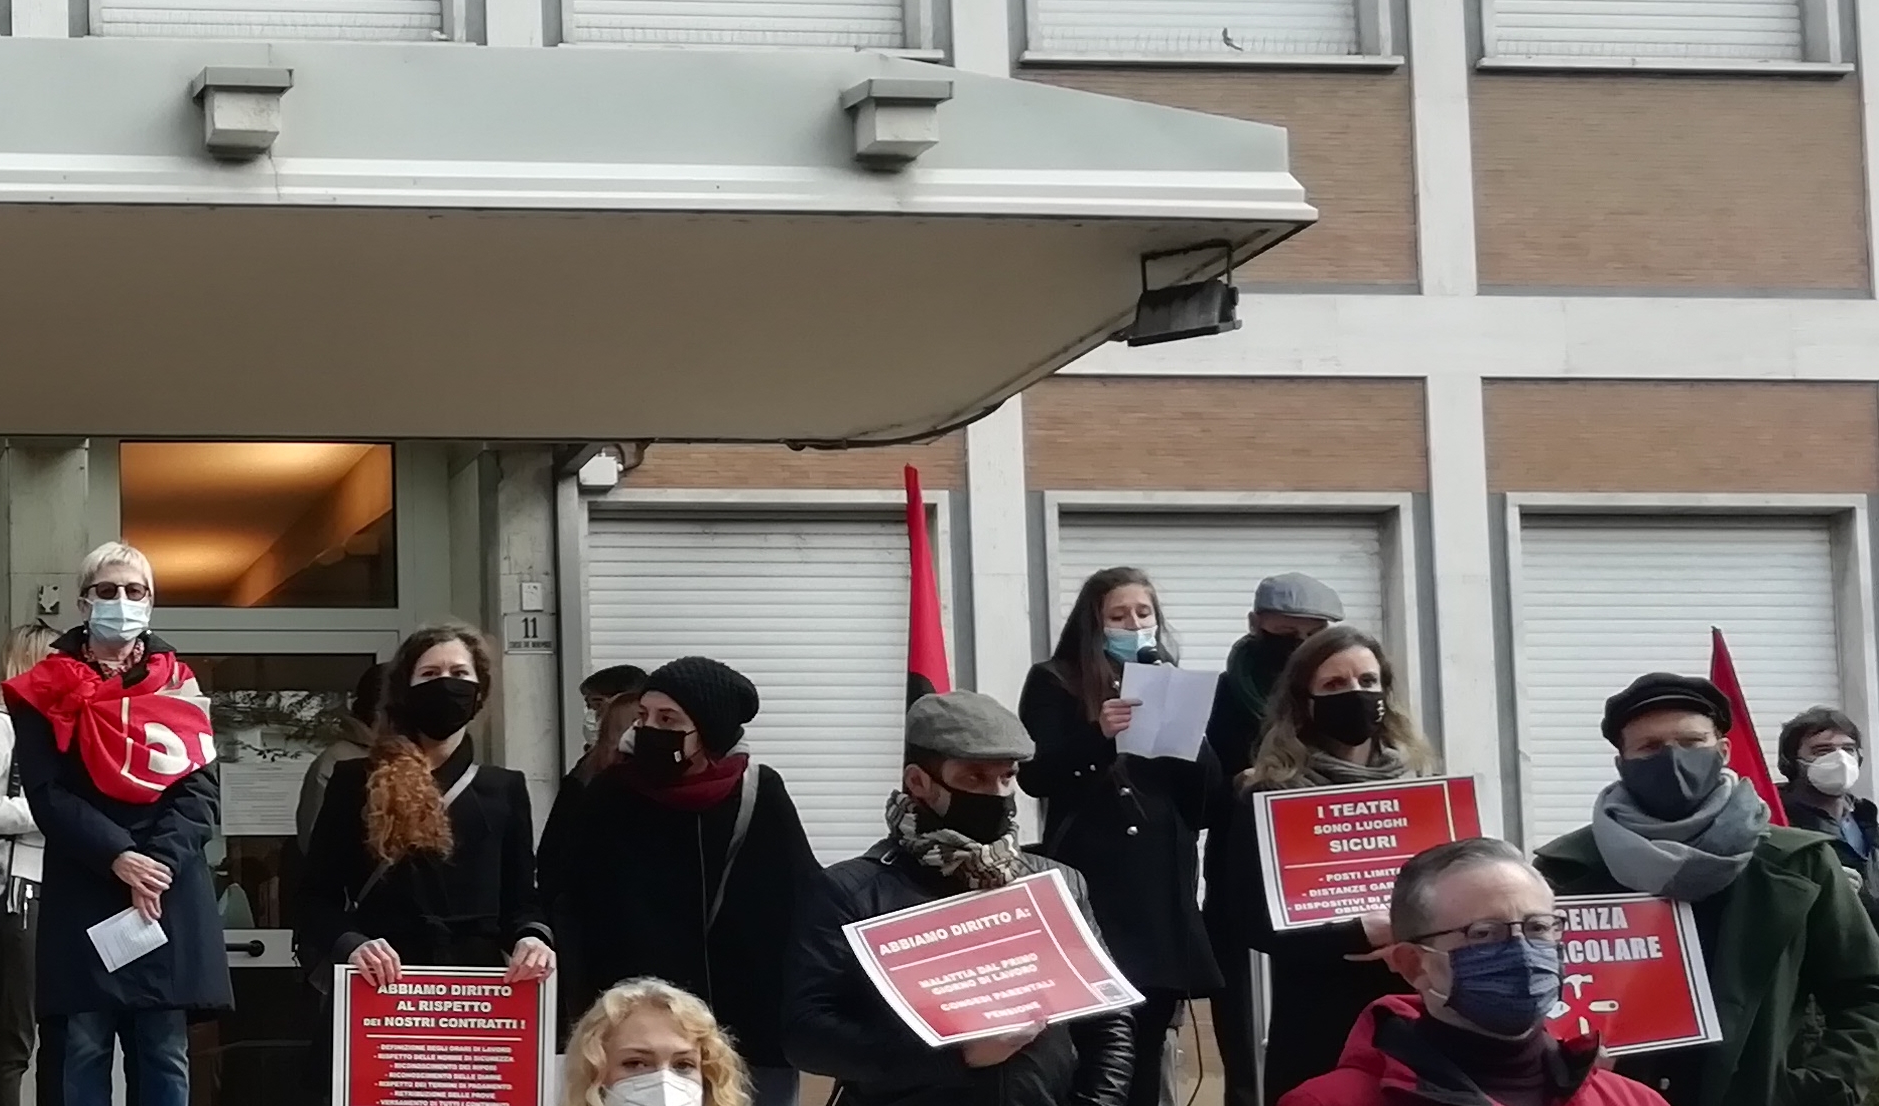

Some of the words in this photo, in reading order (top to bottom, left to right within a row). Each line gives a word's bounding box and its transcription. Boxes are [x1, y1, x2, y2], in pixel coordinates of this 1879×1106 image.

[521, 617, 539, 639] 11
[1317, 805, 1324, 818] I
[1329, 799, 1400, 818] TEATRI
[1313, 823, 1353, 836] SONO
[1355, 817, 1408, 832] LUOGHI
[1329, 834, 1397, 853] SICURI
[1326, 870, 1361, 882] POSTI
[1309, 884, 1367, 897] DISTANZE
[1294, 897, 1365, 911] DISPOSITIVI
[879, 927, 949, 956] ABBIAMO
[950, 910, 1012, 937] DIRITTO
[1015, 907, 1031, 919] A:
[918, 969, 977, 988] MALATTIA
[976, 963, 1001, 975] DAL
[1000, 952, 1038, 968] PRIMO
[931, 979, 977, 995] GIORNO
[991, 963, 1038, 981] LAVORO
[377, 983, 447, 996] ABBIAMO
[451, 984, 513, 997] DIRITTO
[992, 979, 1056, 1000] PARENTALI
[397, 1000, 415, 1011] AL
[418, 1000, 492, 1013] RISPETTO
[982, 1001, 1041, 1019] PENSIONE
[363, 1017, 381, 1026] DEI
[384, 1016, 435, 1028] NOSTRI
[438, 1017, 517, 1029] CONTRATTI
